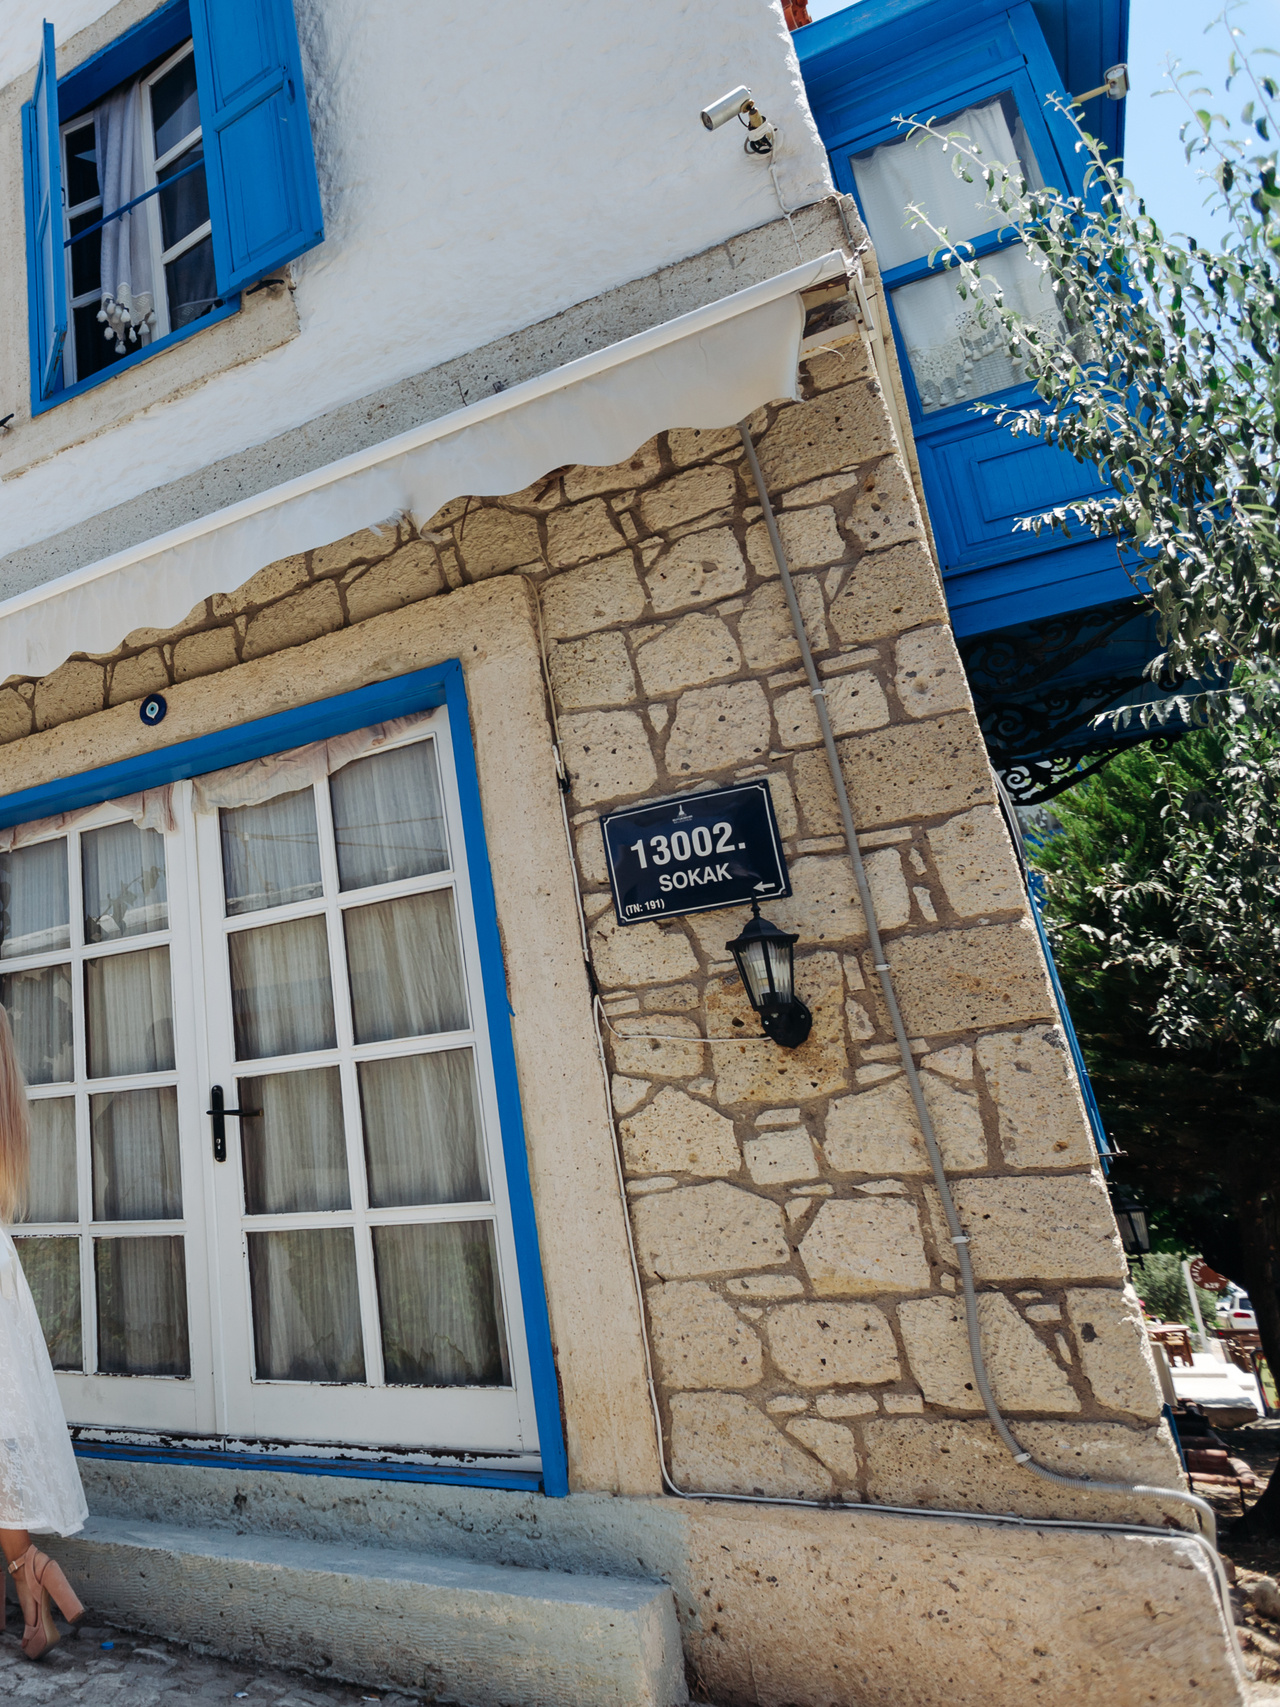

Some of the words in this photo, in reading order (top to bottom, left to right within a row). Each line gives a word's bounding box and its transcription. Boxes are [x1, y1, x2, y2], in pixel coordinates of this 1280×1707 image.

[630, 822, 746, 869] 13002.
[658, 863, 732, 891] SOKAK
[625, 904, 643, 916] (TN:
[644, 898, 664, 910] 191)
